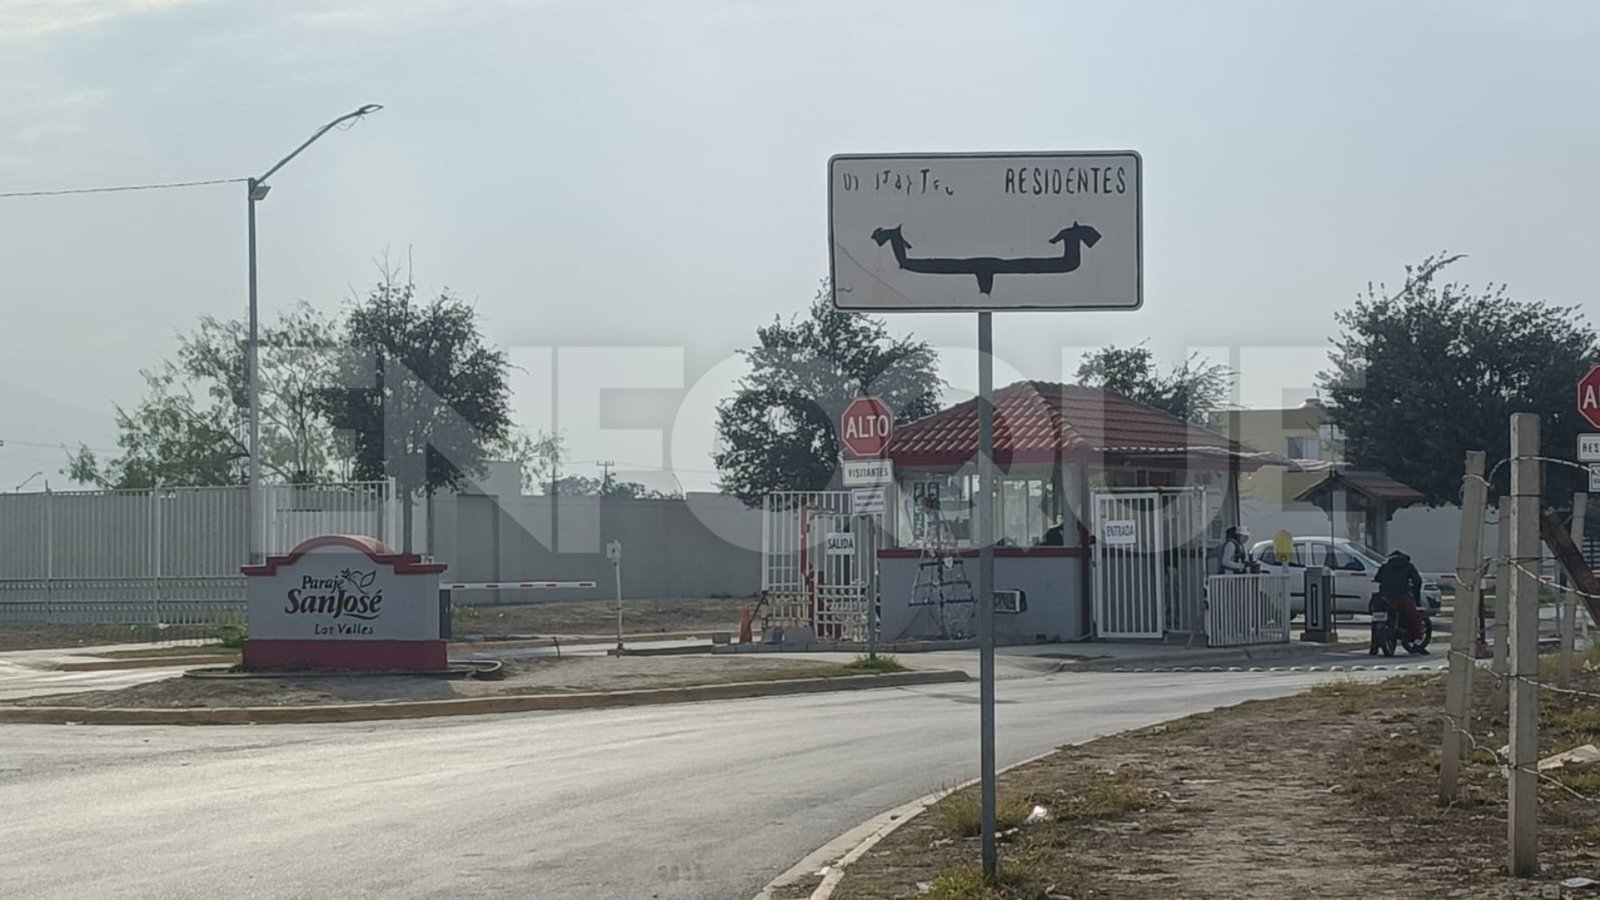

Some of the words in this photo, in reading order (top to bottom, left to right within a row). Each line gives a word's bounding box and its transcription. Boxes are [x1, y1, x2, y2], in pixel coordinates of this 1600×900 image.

[1005, 166, 1126, 195] RESIDENTES
[1583, 384, 1600, 409] A
[845, 414, 889, 439] ALTO
[848, 467, 889, 478] VISITANTES
[1106, 523, 1134, 537] ENTRADA
[827, 537, 854, 549] SALIDA
[302, 574, 345, 592] Paraje
[314, 623, 334, 635] Los
[337, 623, 374, 635] Valles
